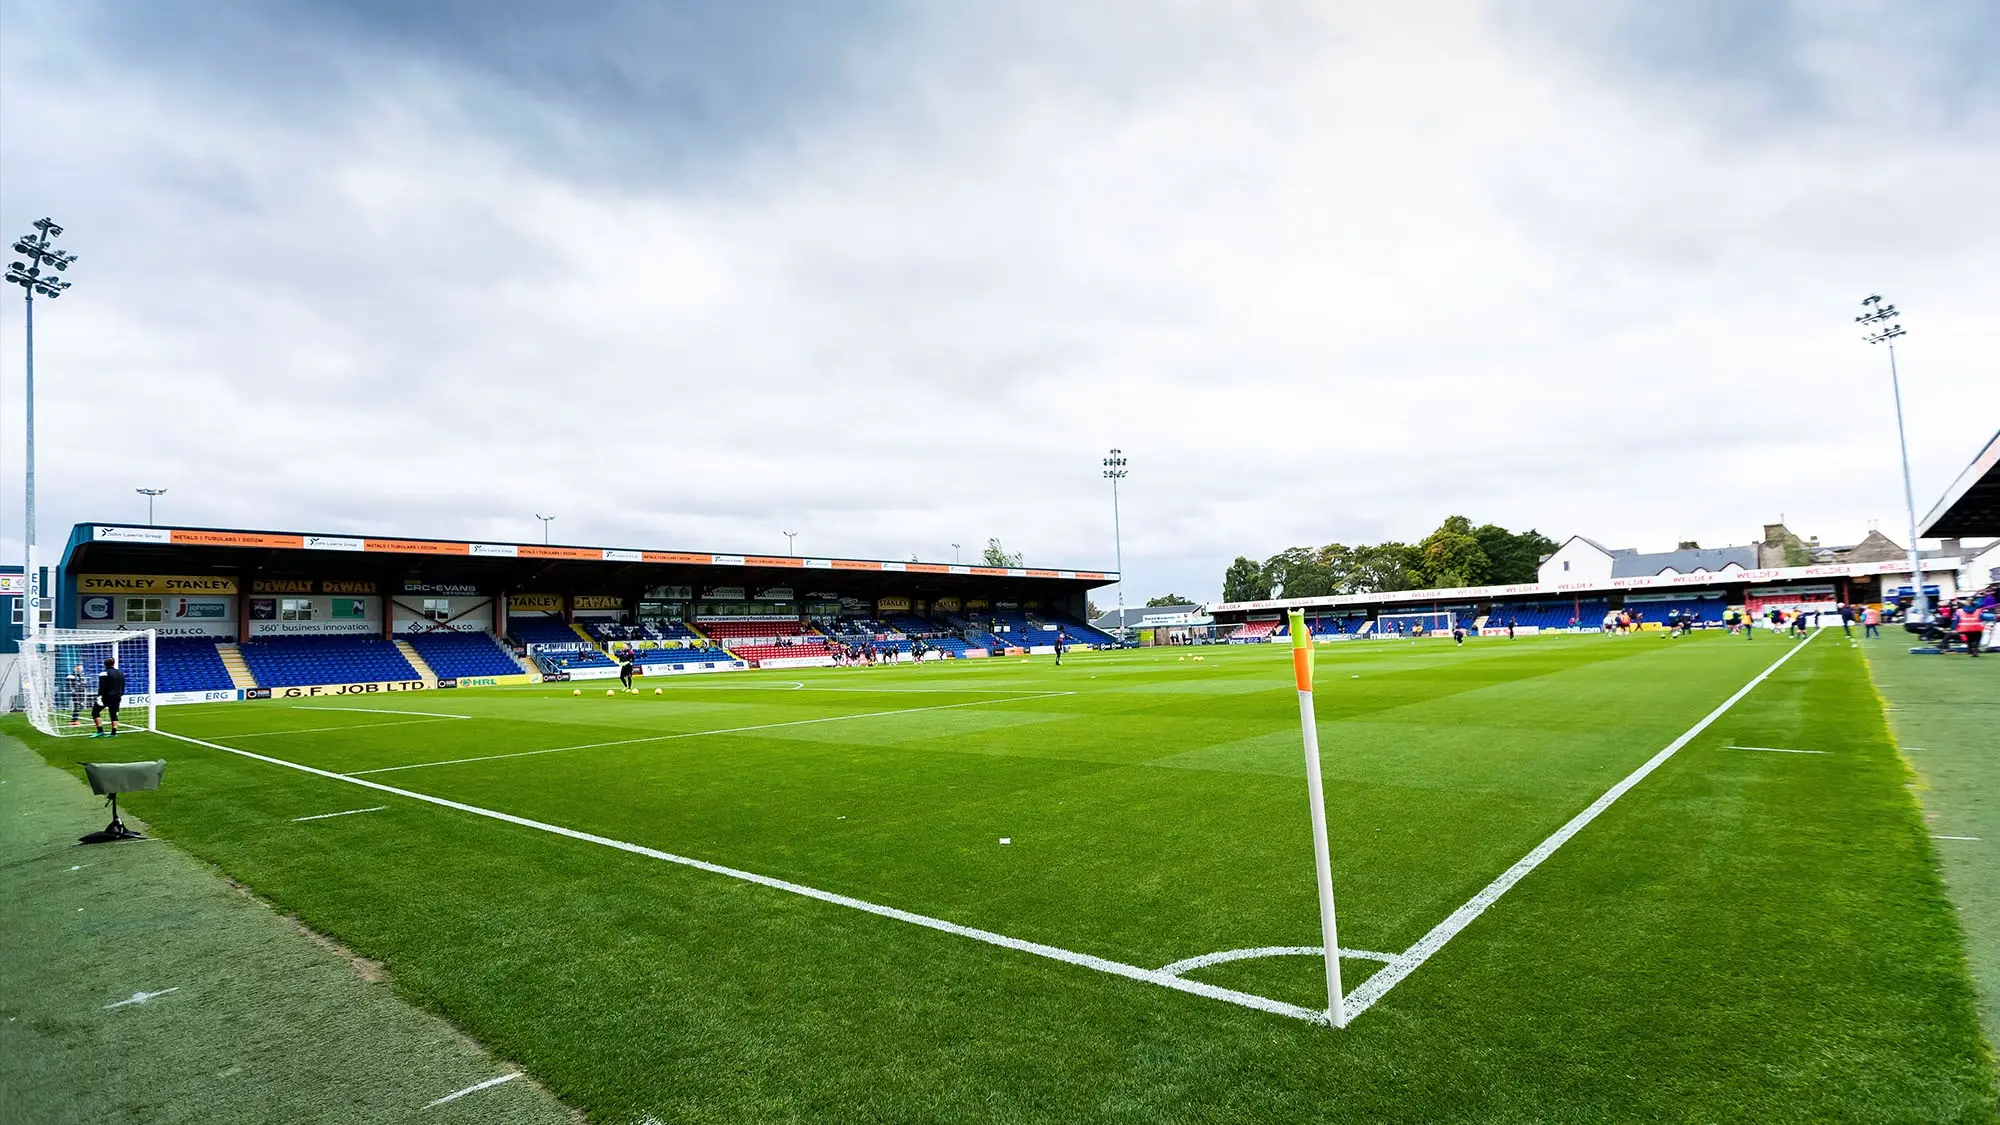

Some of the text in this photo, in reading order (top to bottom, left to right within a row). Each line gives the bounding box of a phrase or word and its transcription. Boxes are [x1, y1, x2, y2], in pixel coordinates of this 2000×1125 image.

[1737, 571, 1781, 579] WELDEX
[1805, 567, 1852, 575] WELDEX
[1673, 575, 1713, 583] WELDEX
[85, 579, 229, 589] STANLEY STANLEY
[404, 584, 476, 592] CRC-EVANS
[31, 573, 39, 608] ERG
[879, 599, 907, 607] STANLEY
[259, 623, 370, 632] 360° business innovation.
[473, 678, 496, 686] HRL
[286, 681, 424, 698] G.F. JOB LTD
[205, 691, 229, 700] ERG
